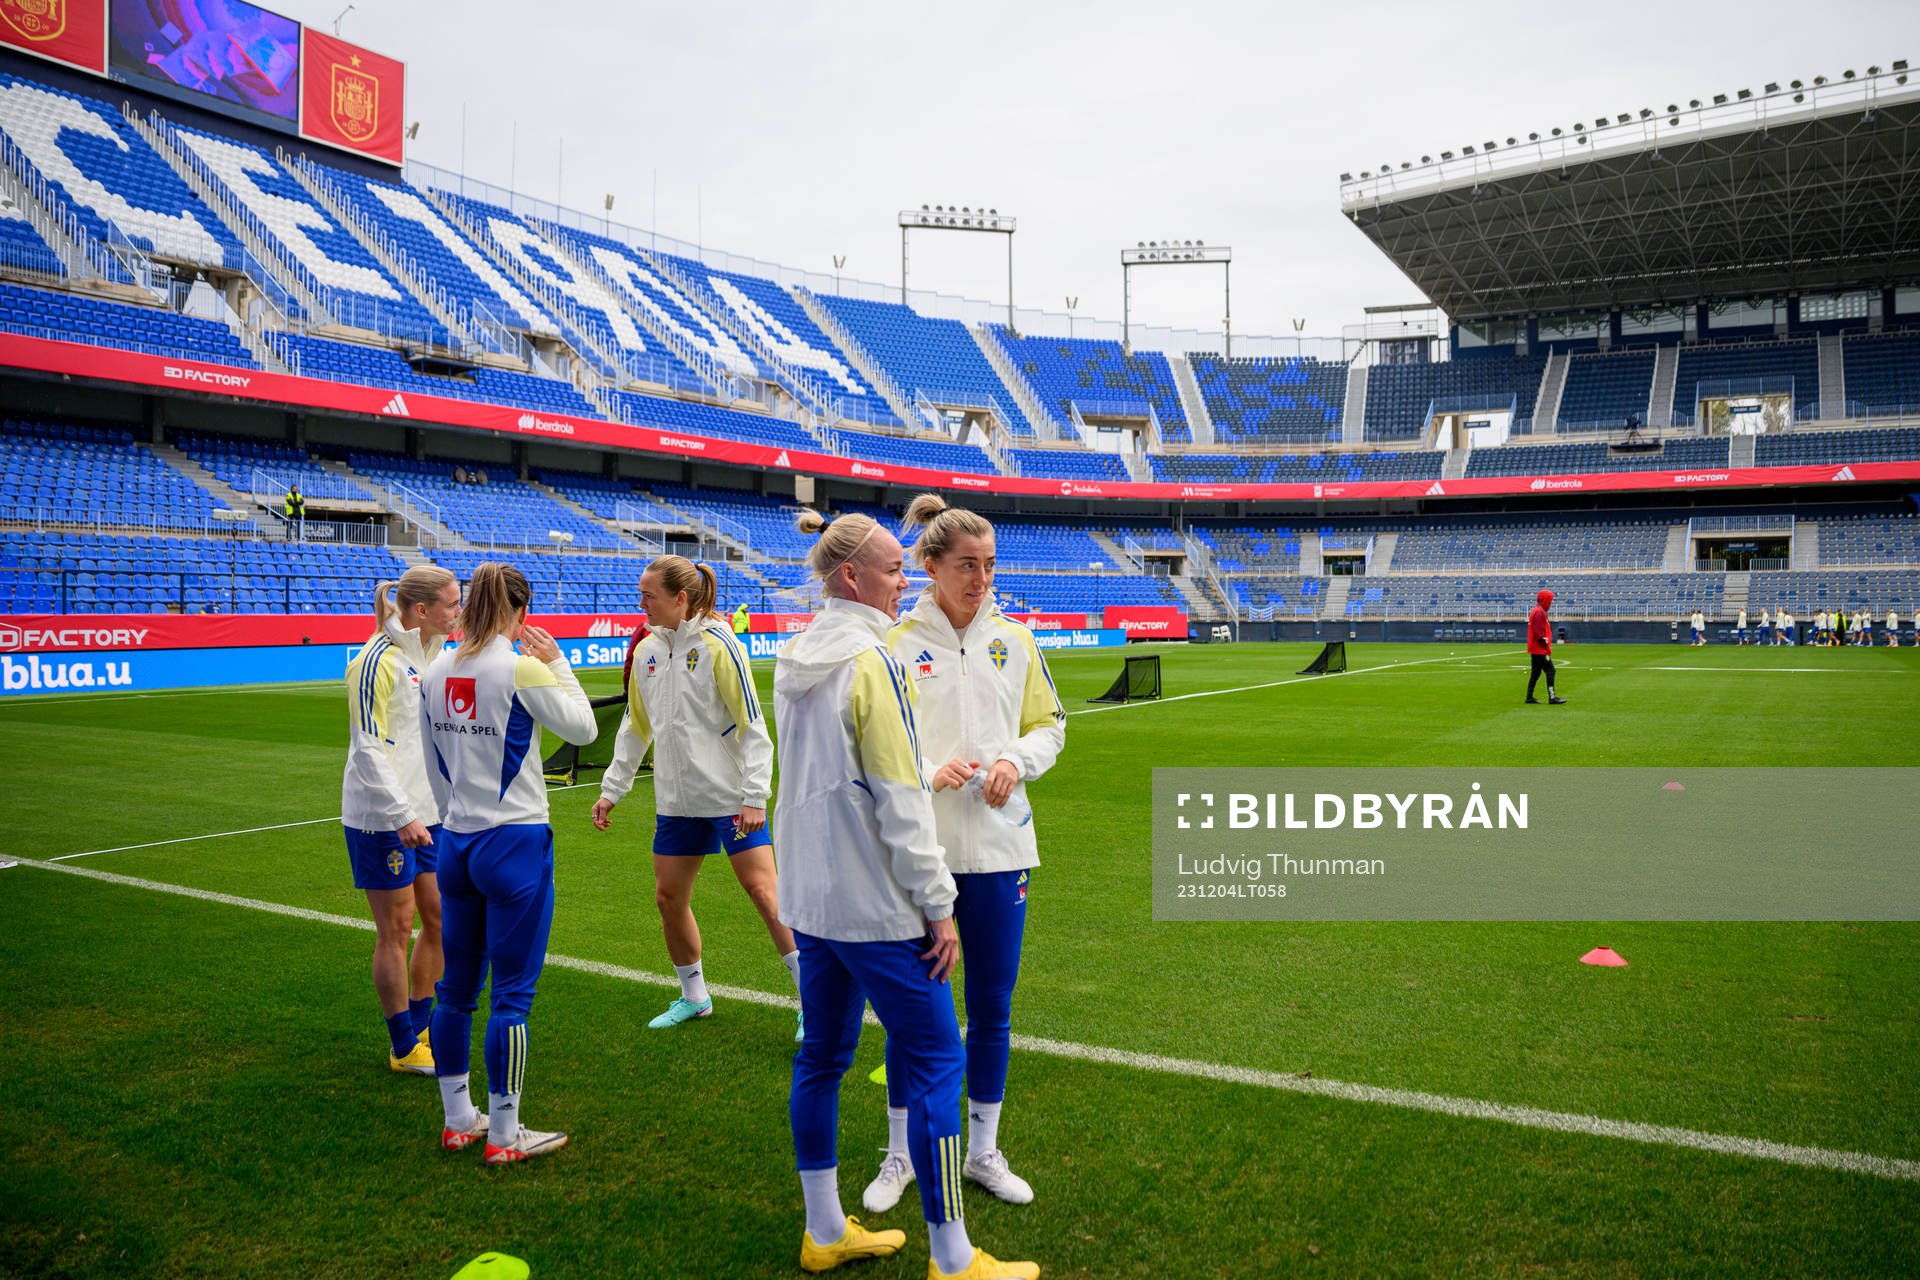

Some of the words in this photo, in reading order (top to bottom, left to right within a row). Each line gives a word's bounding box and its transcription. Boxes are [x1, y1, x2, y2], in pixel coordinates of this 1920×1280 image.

[184, 369, 251, 388] FACTORY
[535, 417, 575, 434] Iberdrola
[670, 438, 706, 450] FACTORY
[1546, 479, 1583, 489] Iberdrola
[1686, 473, 1730, 482] FACTORY
[1129, 621, 1169, 631] FACTORY
[23, 629, 149, 647] FACTORY
[1035, 631, 1071, 649] consigue
[1072, 630, 1099, 646] blua.u
[1, 655, 132, 690] blua.u
[471, 725, 499, 737] SPEL
